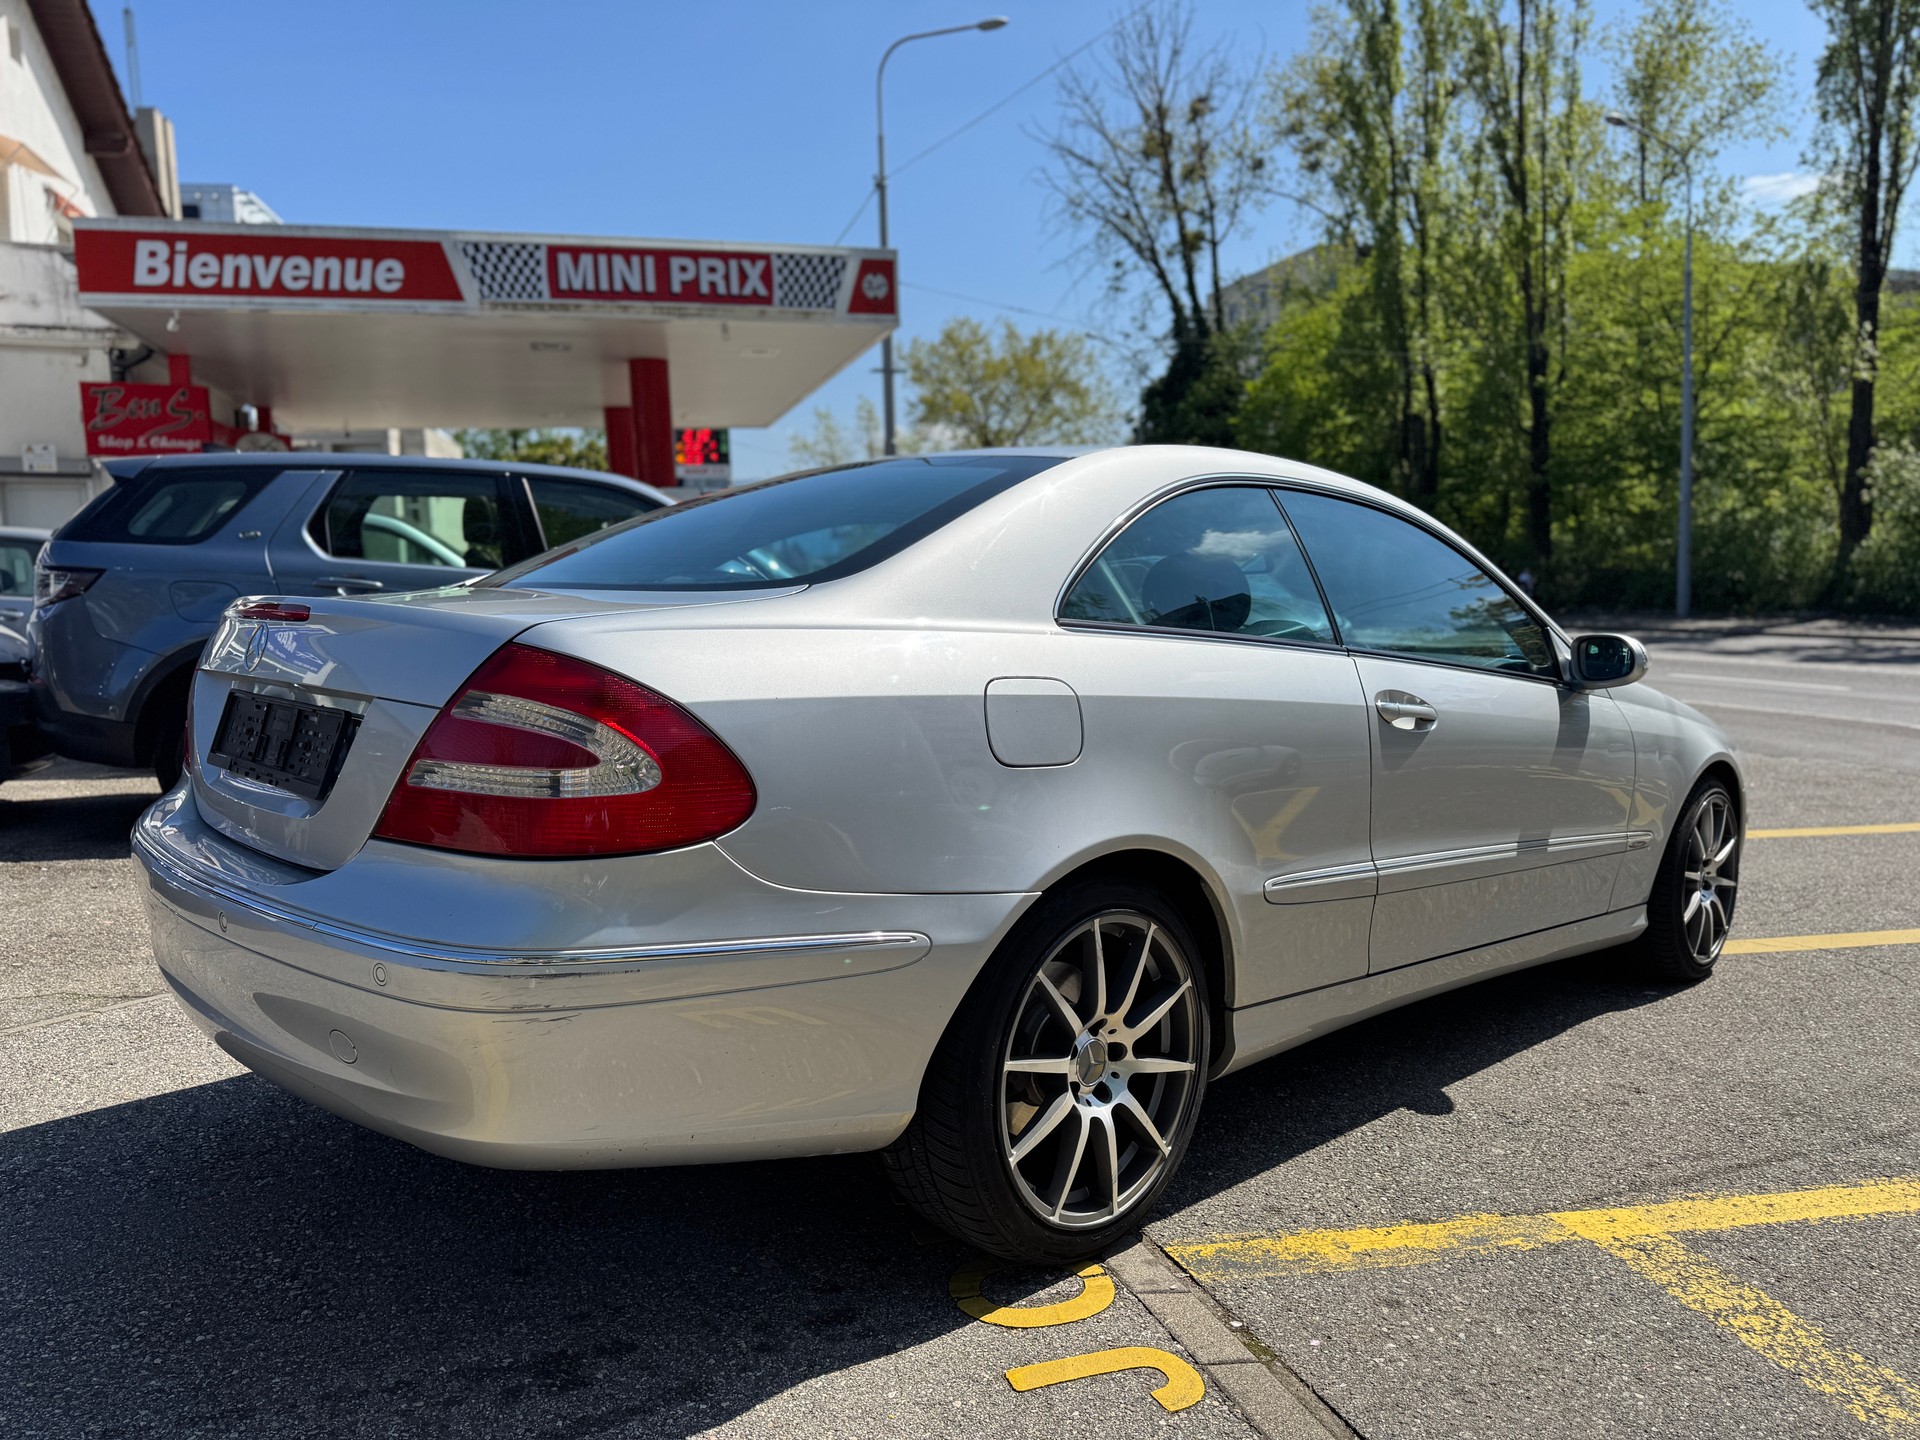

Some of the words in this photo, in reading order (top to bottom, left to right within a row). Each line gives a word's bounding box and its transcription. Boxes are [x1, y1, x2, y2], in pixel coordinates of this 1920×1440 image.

[133, 239, 405, 293] Bienvenue
[556, 251, 657, 294] MINI
[668, 255, 770, 298] PRIX
[88, 386, 161, 432] Ben
[98, 435, 133, 450] Shop
